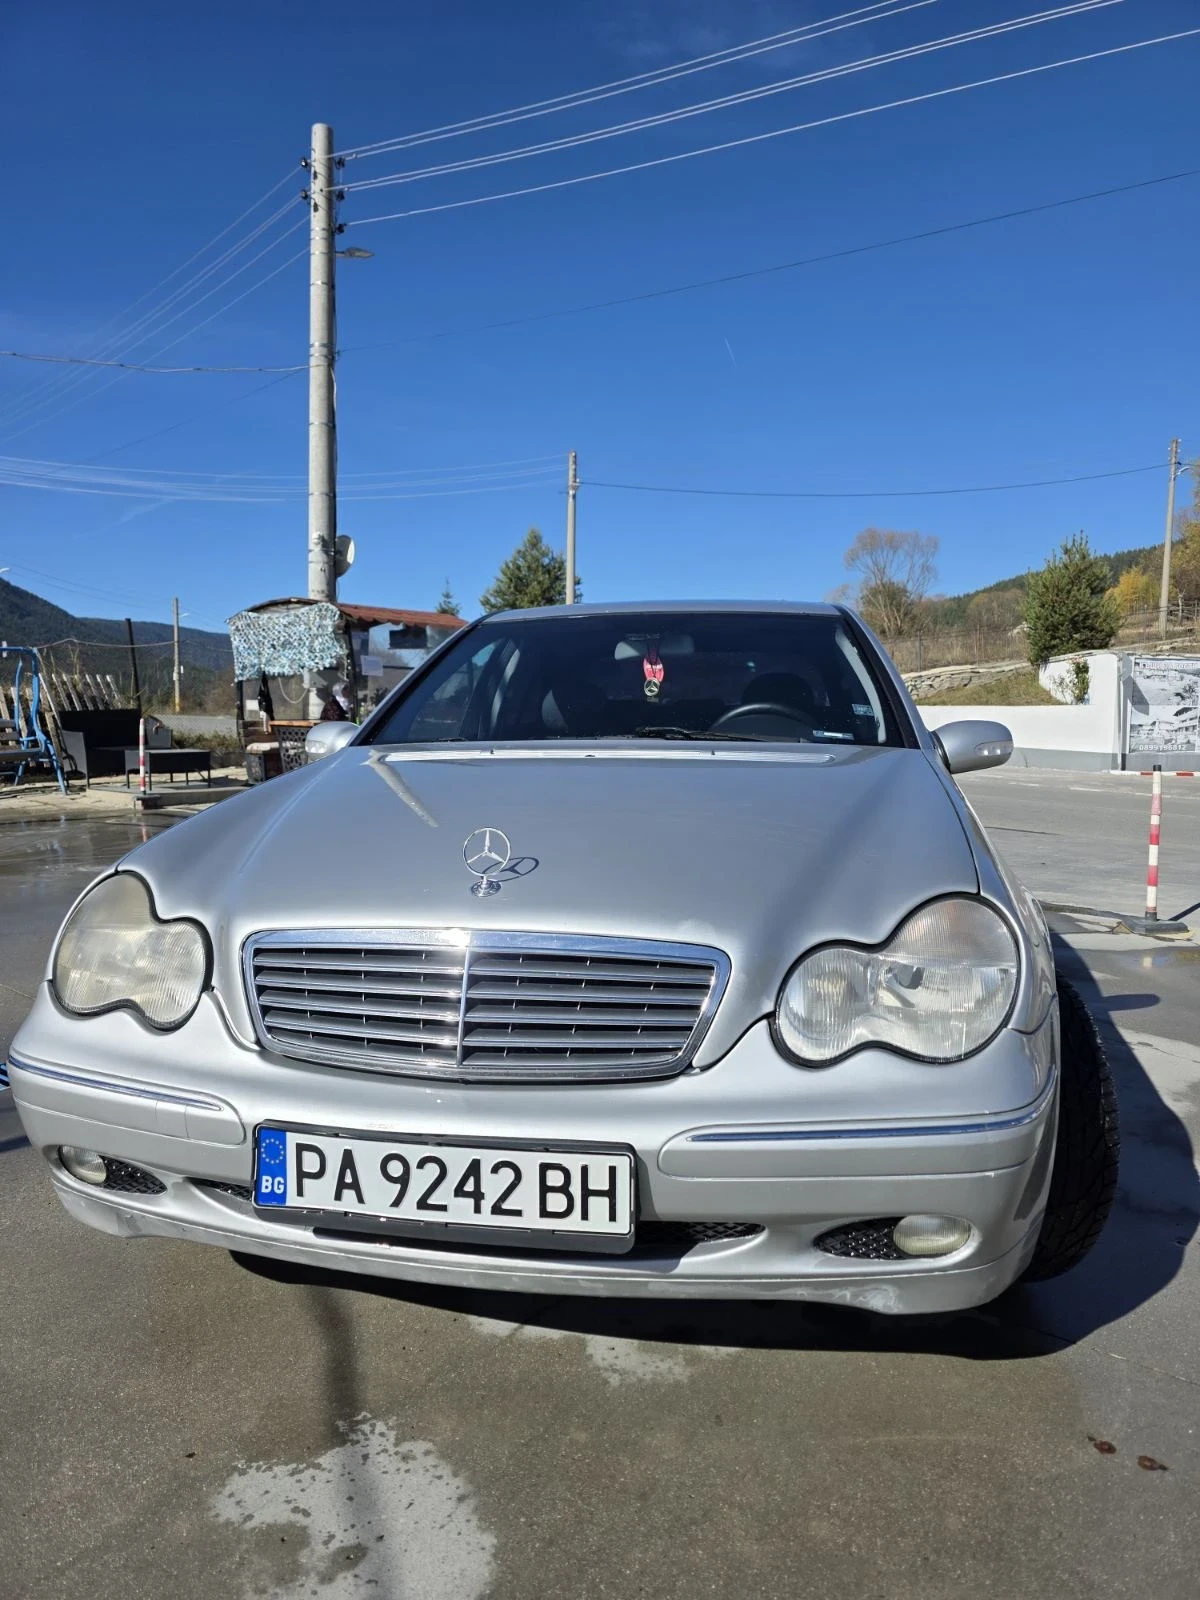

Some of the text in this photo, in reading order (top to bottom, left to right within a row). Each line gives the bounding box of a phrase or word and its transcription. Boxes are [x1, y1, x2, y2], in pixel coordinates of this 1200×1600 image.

[261, 1175, 285, 1194] BG
[295, 1142, 617, 1222] PA 9242 BH
